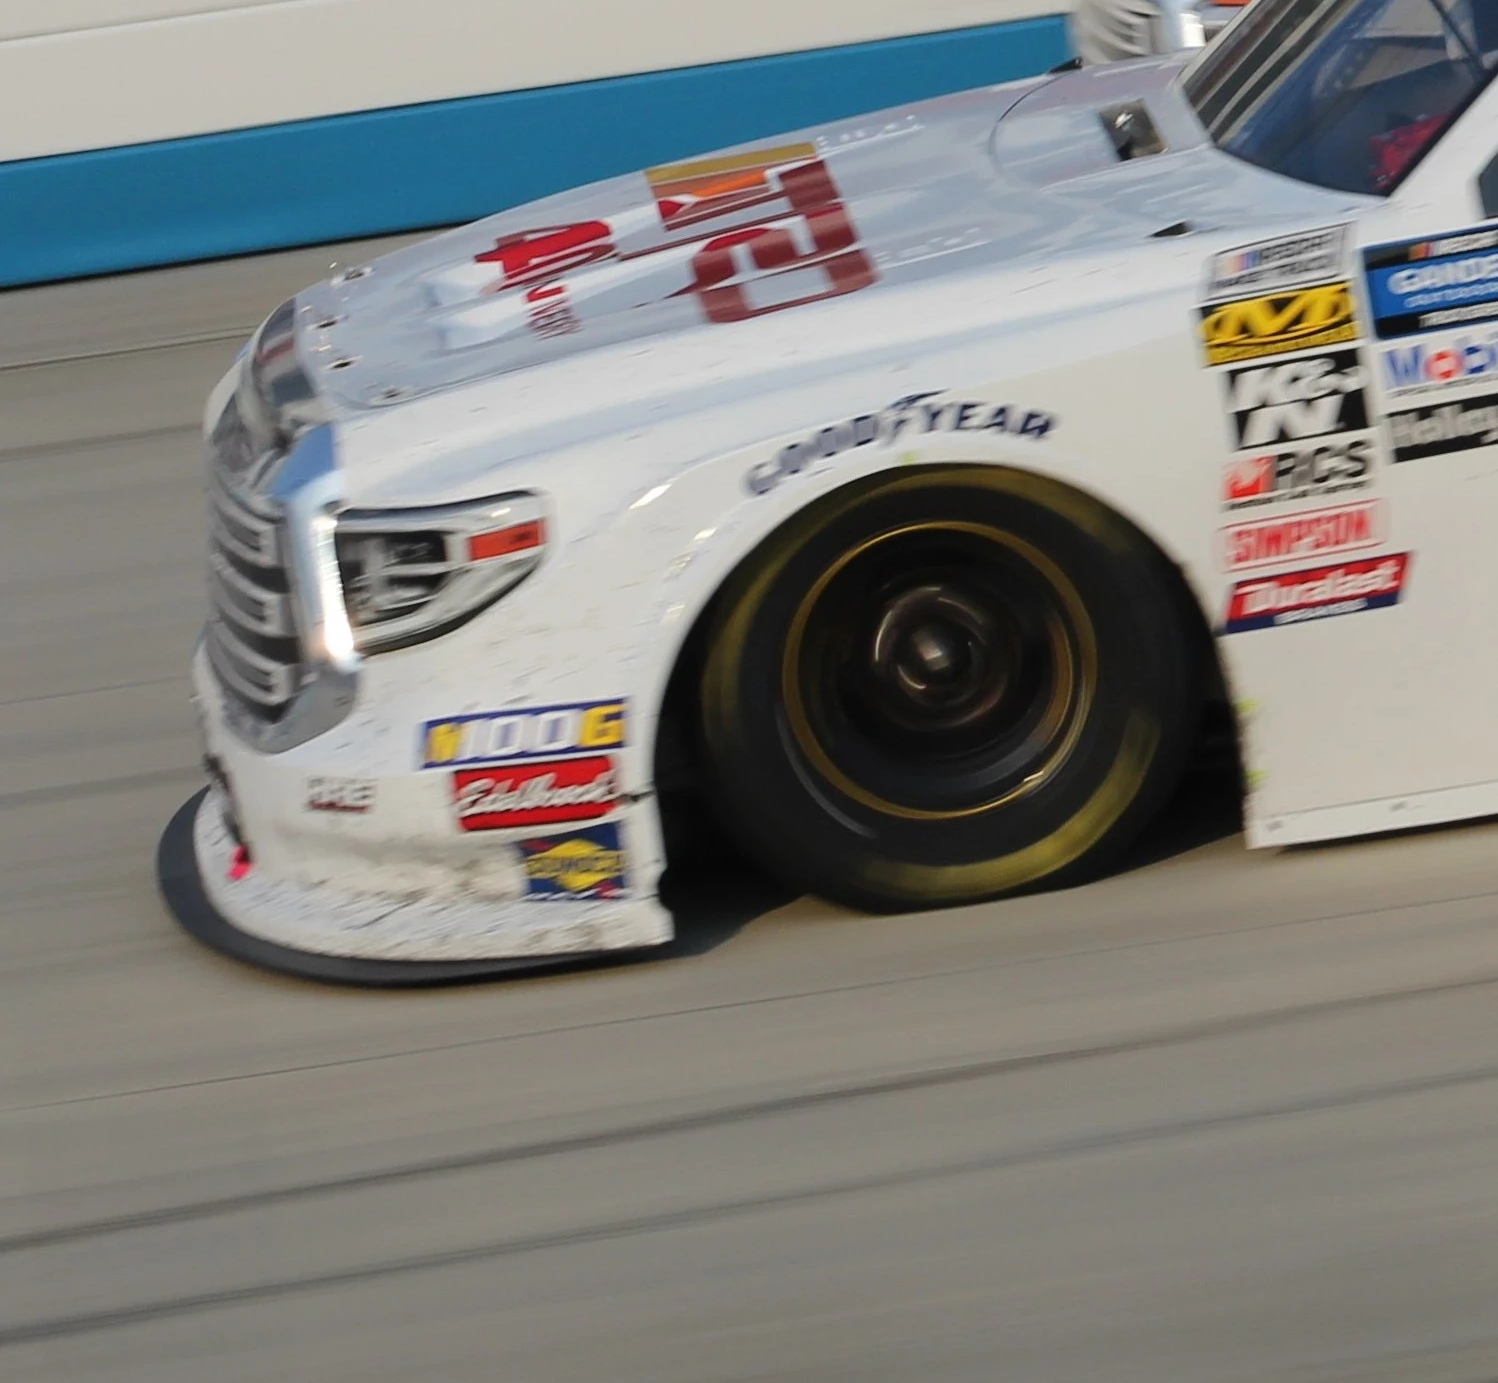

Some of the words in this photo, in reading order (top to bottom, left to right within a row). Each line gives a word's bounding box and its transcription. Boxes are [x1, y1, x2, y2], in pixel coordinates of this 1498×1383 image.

[743, 391, 1060, 496] GOODYEAR
[1228, 508, 1374, 566] SIMPSON
[1234, 561, 1401, 616] Duralast
